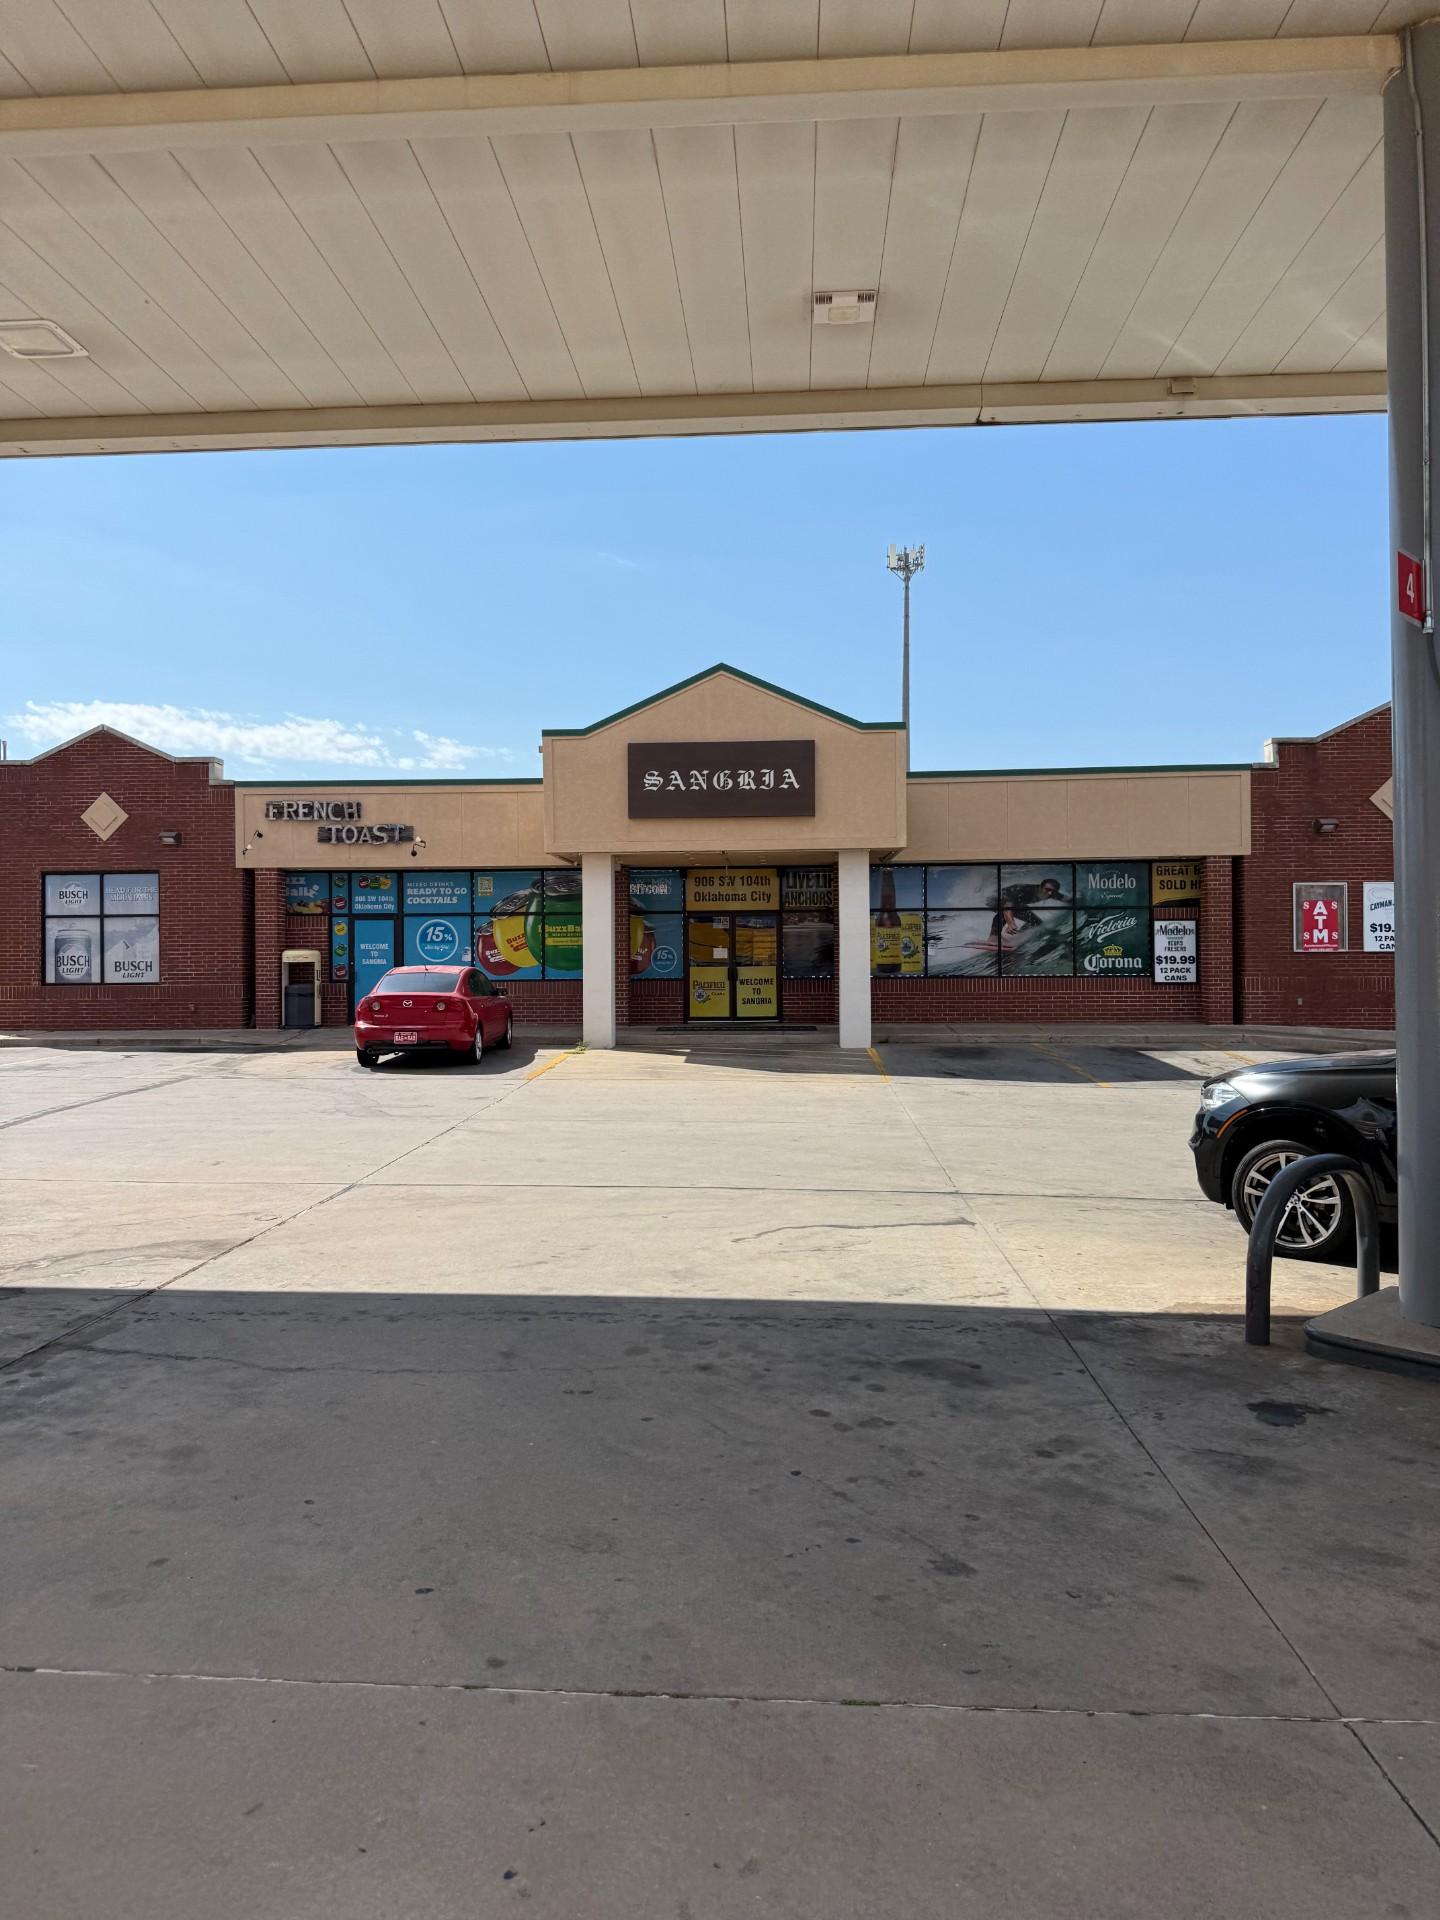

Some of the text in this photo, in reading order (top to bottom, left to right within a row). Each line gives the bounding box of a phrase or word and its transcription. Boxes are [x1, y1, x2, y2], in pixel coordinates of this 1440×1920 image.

[1406, 572, 1415, 604] 4
[643, 768, 800, 792] SANGRIA
[266, 800, 362, 821] FRENCH
[325, 824, 405, 845] TOAST
[1156, 866, 1190, 876] GREAT
[694, 875, 770, 887] 906 SW 104th
[1088, 873, 1137, 890] Modelo
[1160, 880, 1186, 890] SOLD
[59, 890, 88, 899] BUSCH
[694, 890, 772, 903] Oklahoma City
[785, 891, 832, 906] ANCHORS
[1370, 900, 1393, 911] CAYMAN
[1088, 911, 1137, 943] Victoria
[1312, 901, 1329, 943] ATM
[1159, 925, 1192, 936] Modelo
[56, 956, 90, 967] BUSCH
[1084, 953, 1142, 973] Corona
[1156, 955, 1196, 965] $19.99
[114, 961, 153, 972] BUSCH
[739, 978, 774, 986] WELCOME
[742, 997, 772, 1005] SANGRIA
